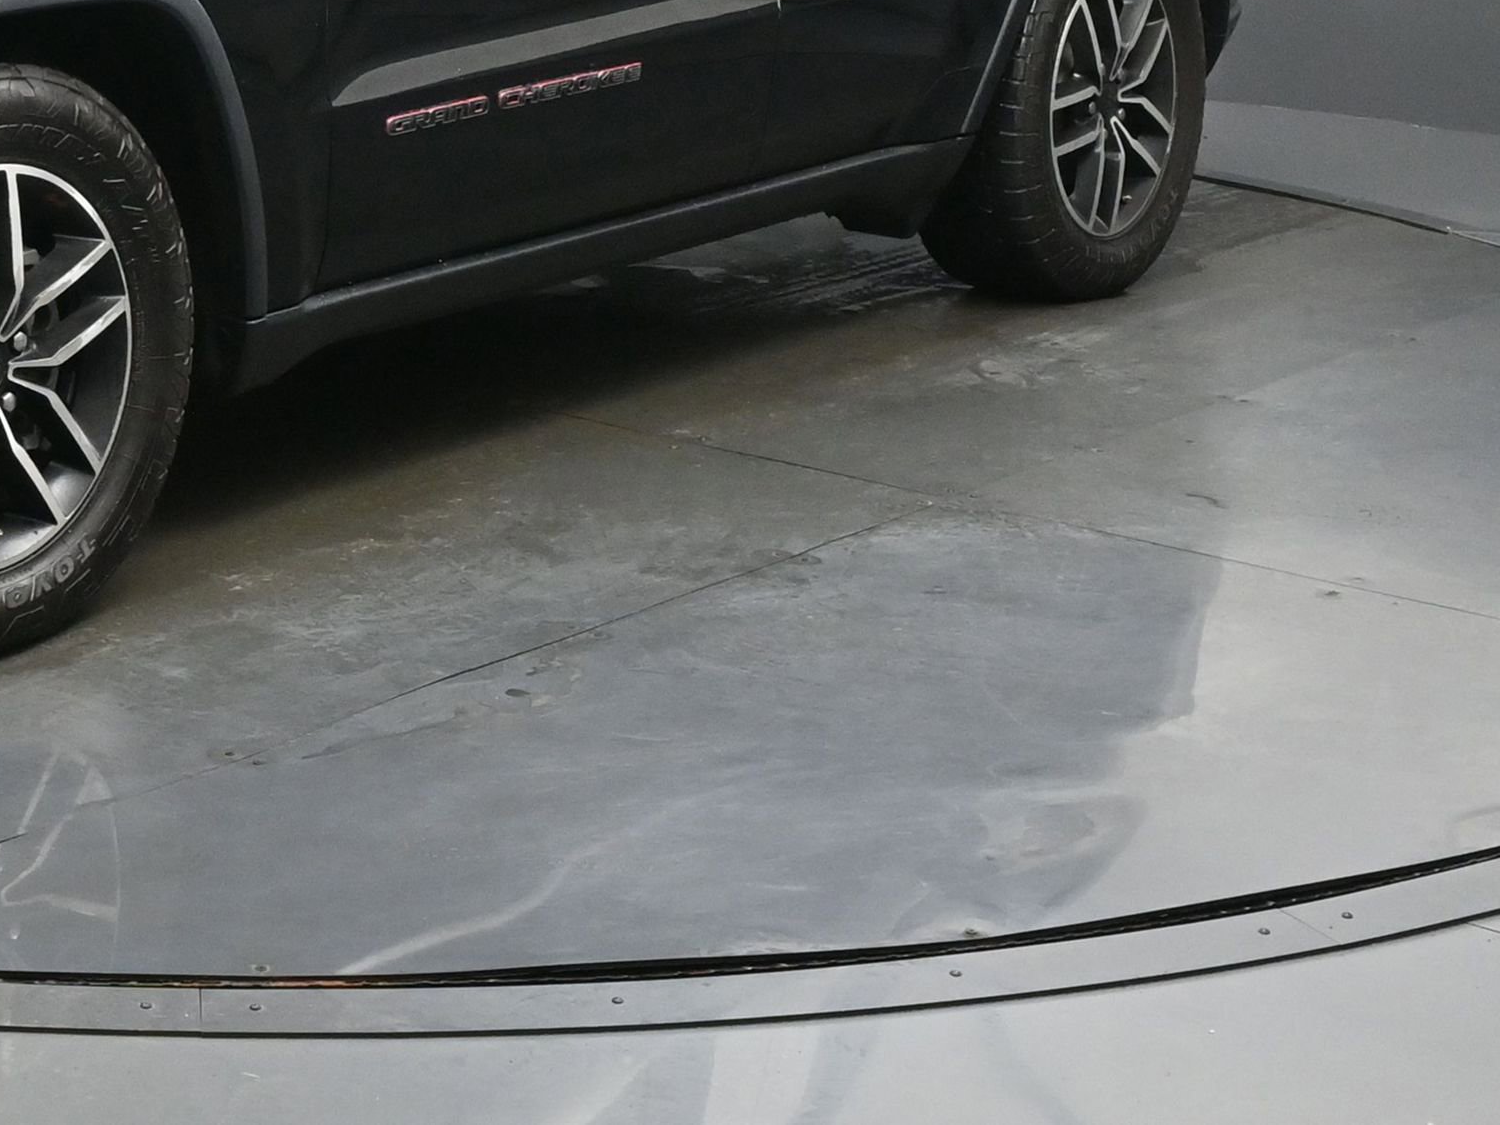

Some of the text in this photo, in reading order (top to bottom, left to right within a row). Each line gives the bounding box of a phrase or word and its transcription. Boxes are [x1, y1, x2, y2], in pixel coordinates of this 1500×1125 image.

[386, 62, 642, 136] GRAND CHEROKEE
[0, 537, 97, 610] TOYO
